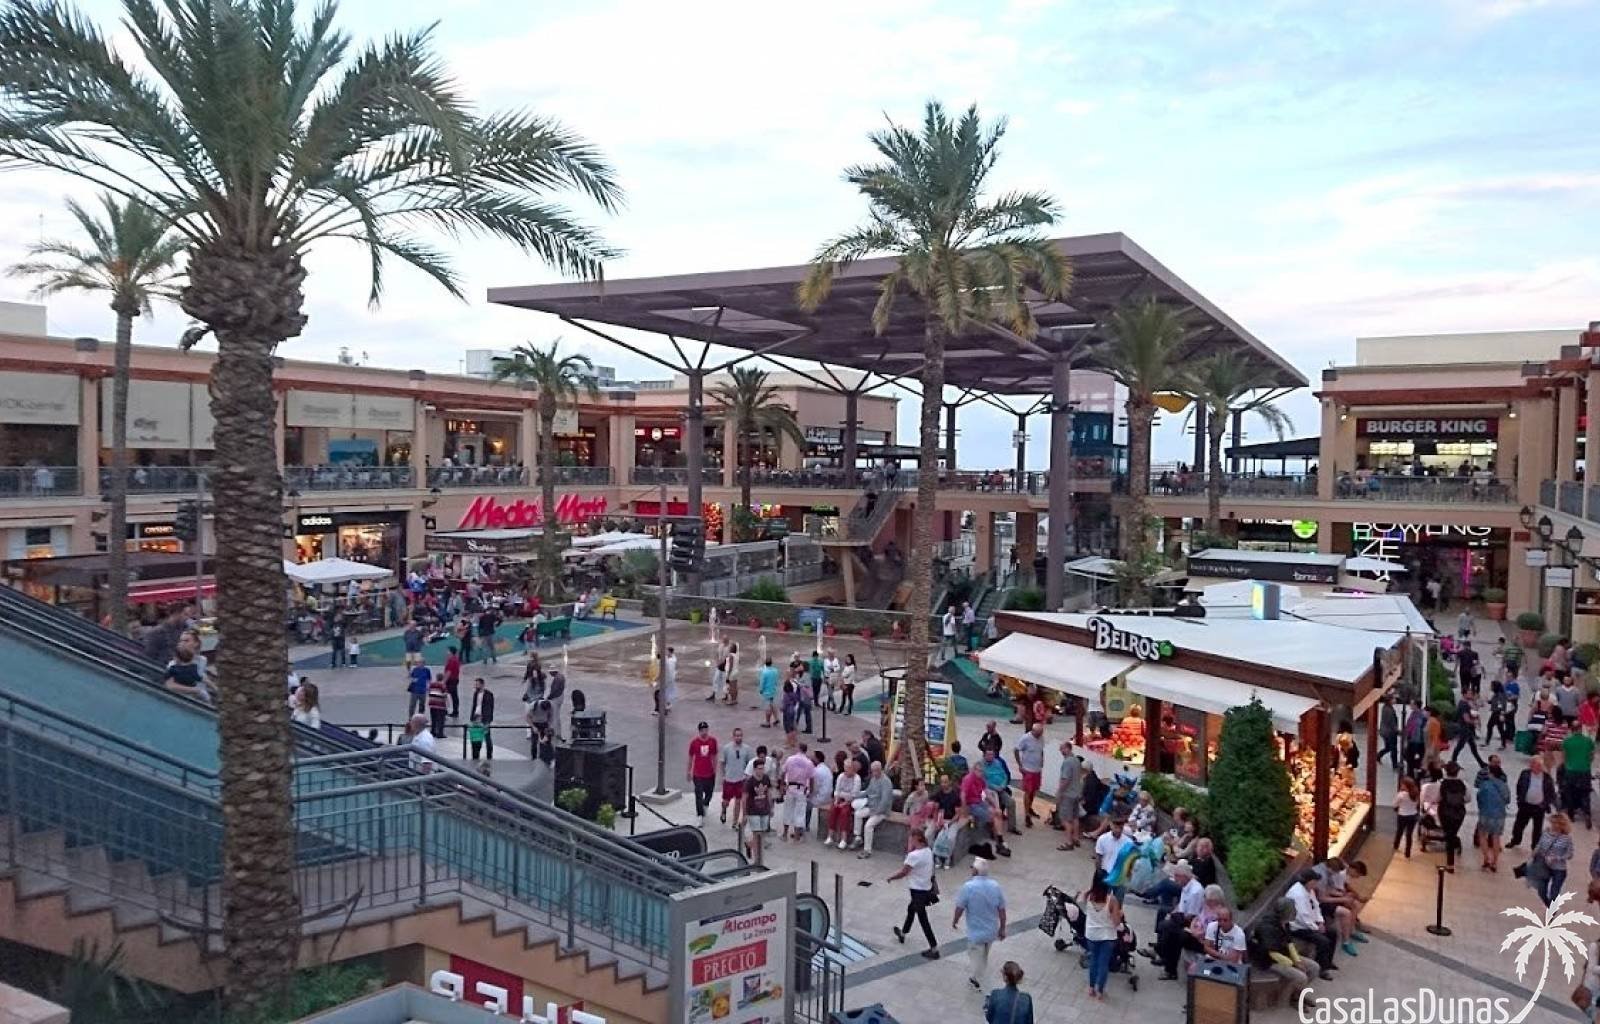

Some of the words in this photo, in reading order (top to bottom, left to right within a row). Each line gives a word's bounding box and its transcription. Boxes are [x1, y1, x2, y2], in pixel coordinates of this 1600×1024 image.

[1366, 420, 1436, 433] BURGER
[1440, 420, 1487, 433] KING
[301, 516, 332, 526] adidas
[458, 496, 538, 528] Media
[1088, 617, 1160, 661] BELROS
[722, 912, 777, 935] Alcampo
[703, 950, 757, 982] PRECIO
